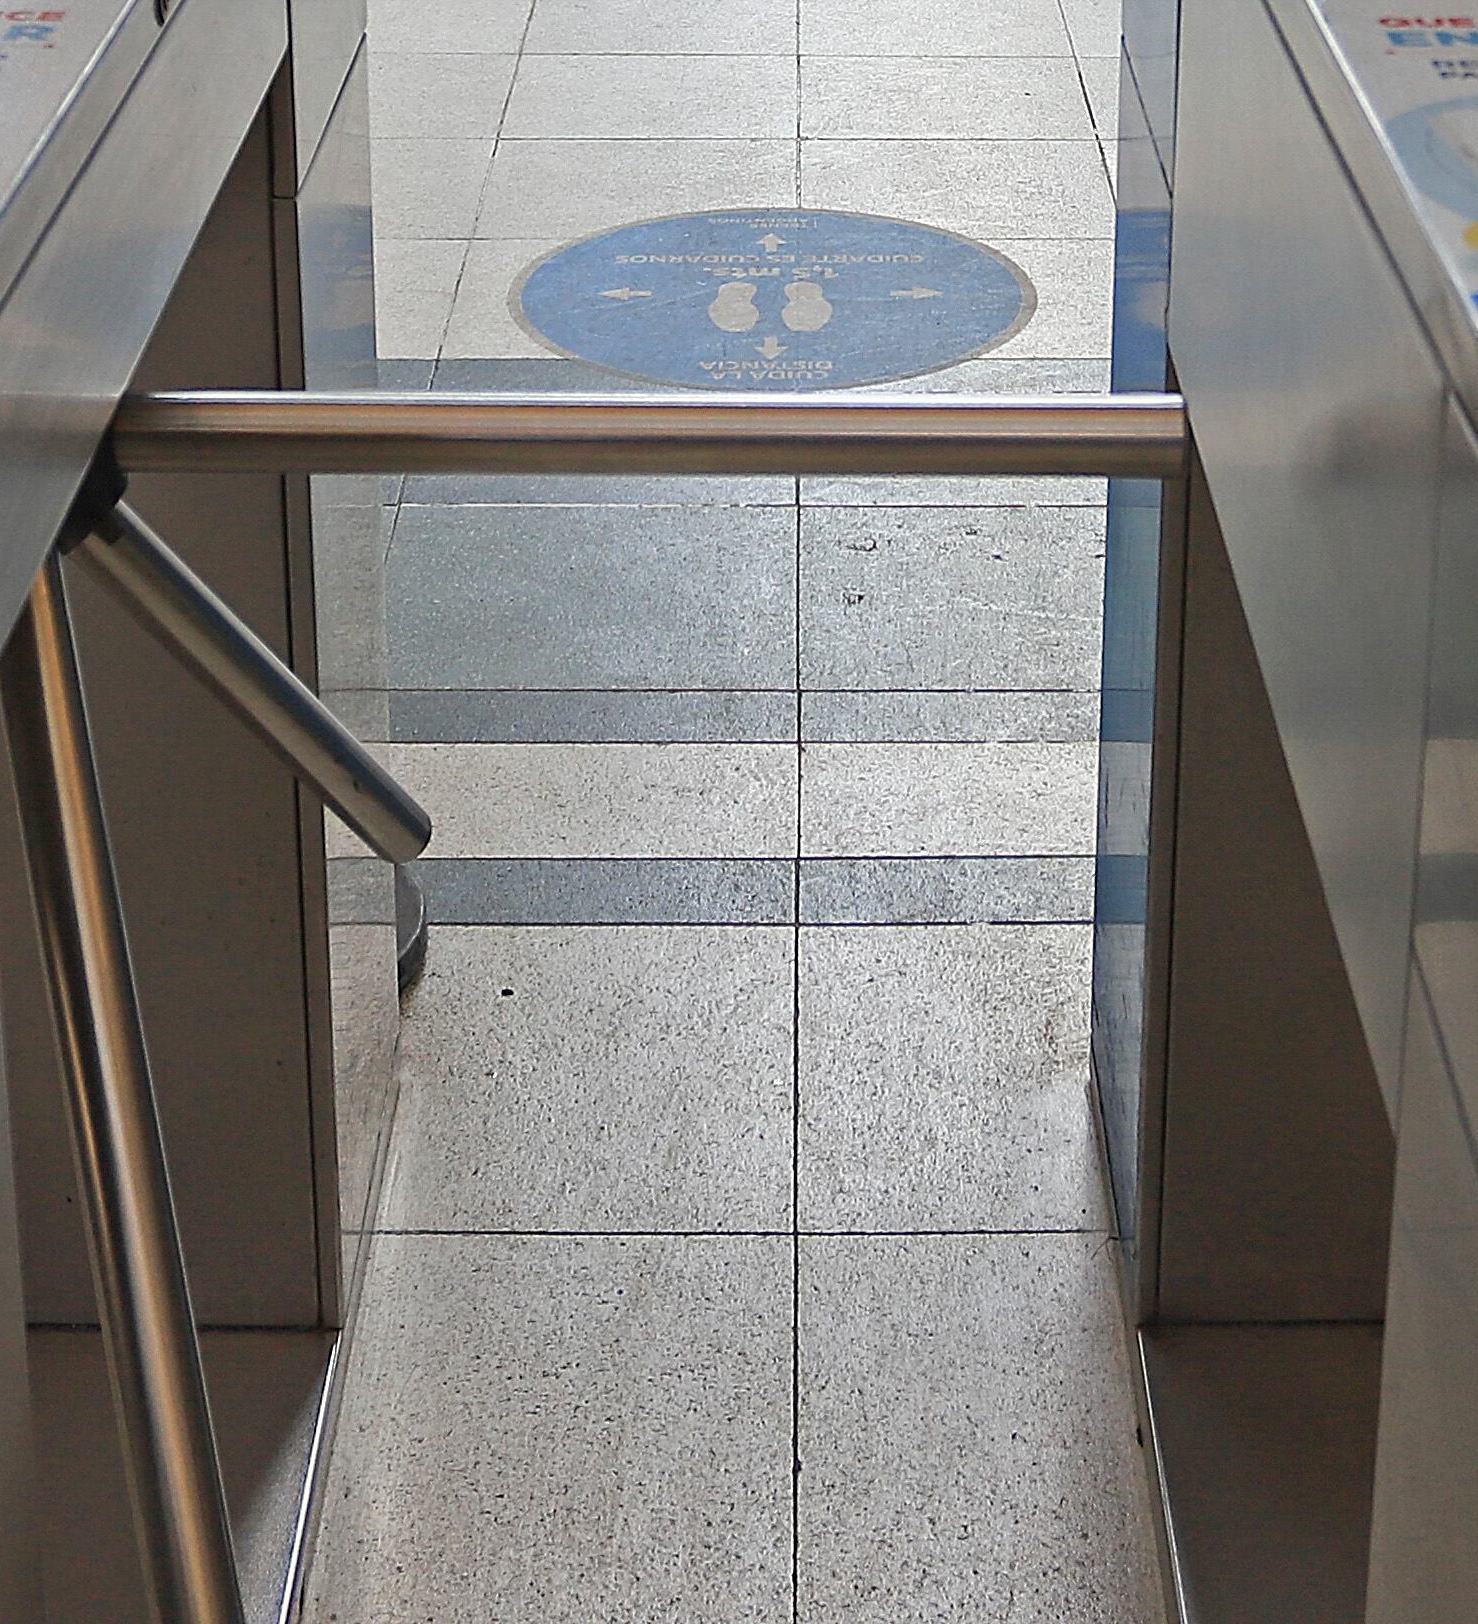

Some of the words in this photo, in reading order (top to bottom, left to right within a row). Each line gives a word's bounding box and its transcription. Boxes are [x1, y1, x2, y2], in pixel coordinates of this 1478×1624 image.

[1378, 17, 1478, 28] QUE
[615, 255, 760, 263] CUIDARNOS
[766, 255, 795, 263] ES
[802, 255, 924, 264] CUIDARTE
[702, 267, 781, 278] mts.
[792, 266, 839, 278] 1,5
[699, 361, 833, 370] DISTANCIA
[709, 371, 742, 379] LA
